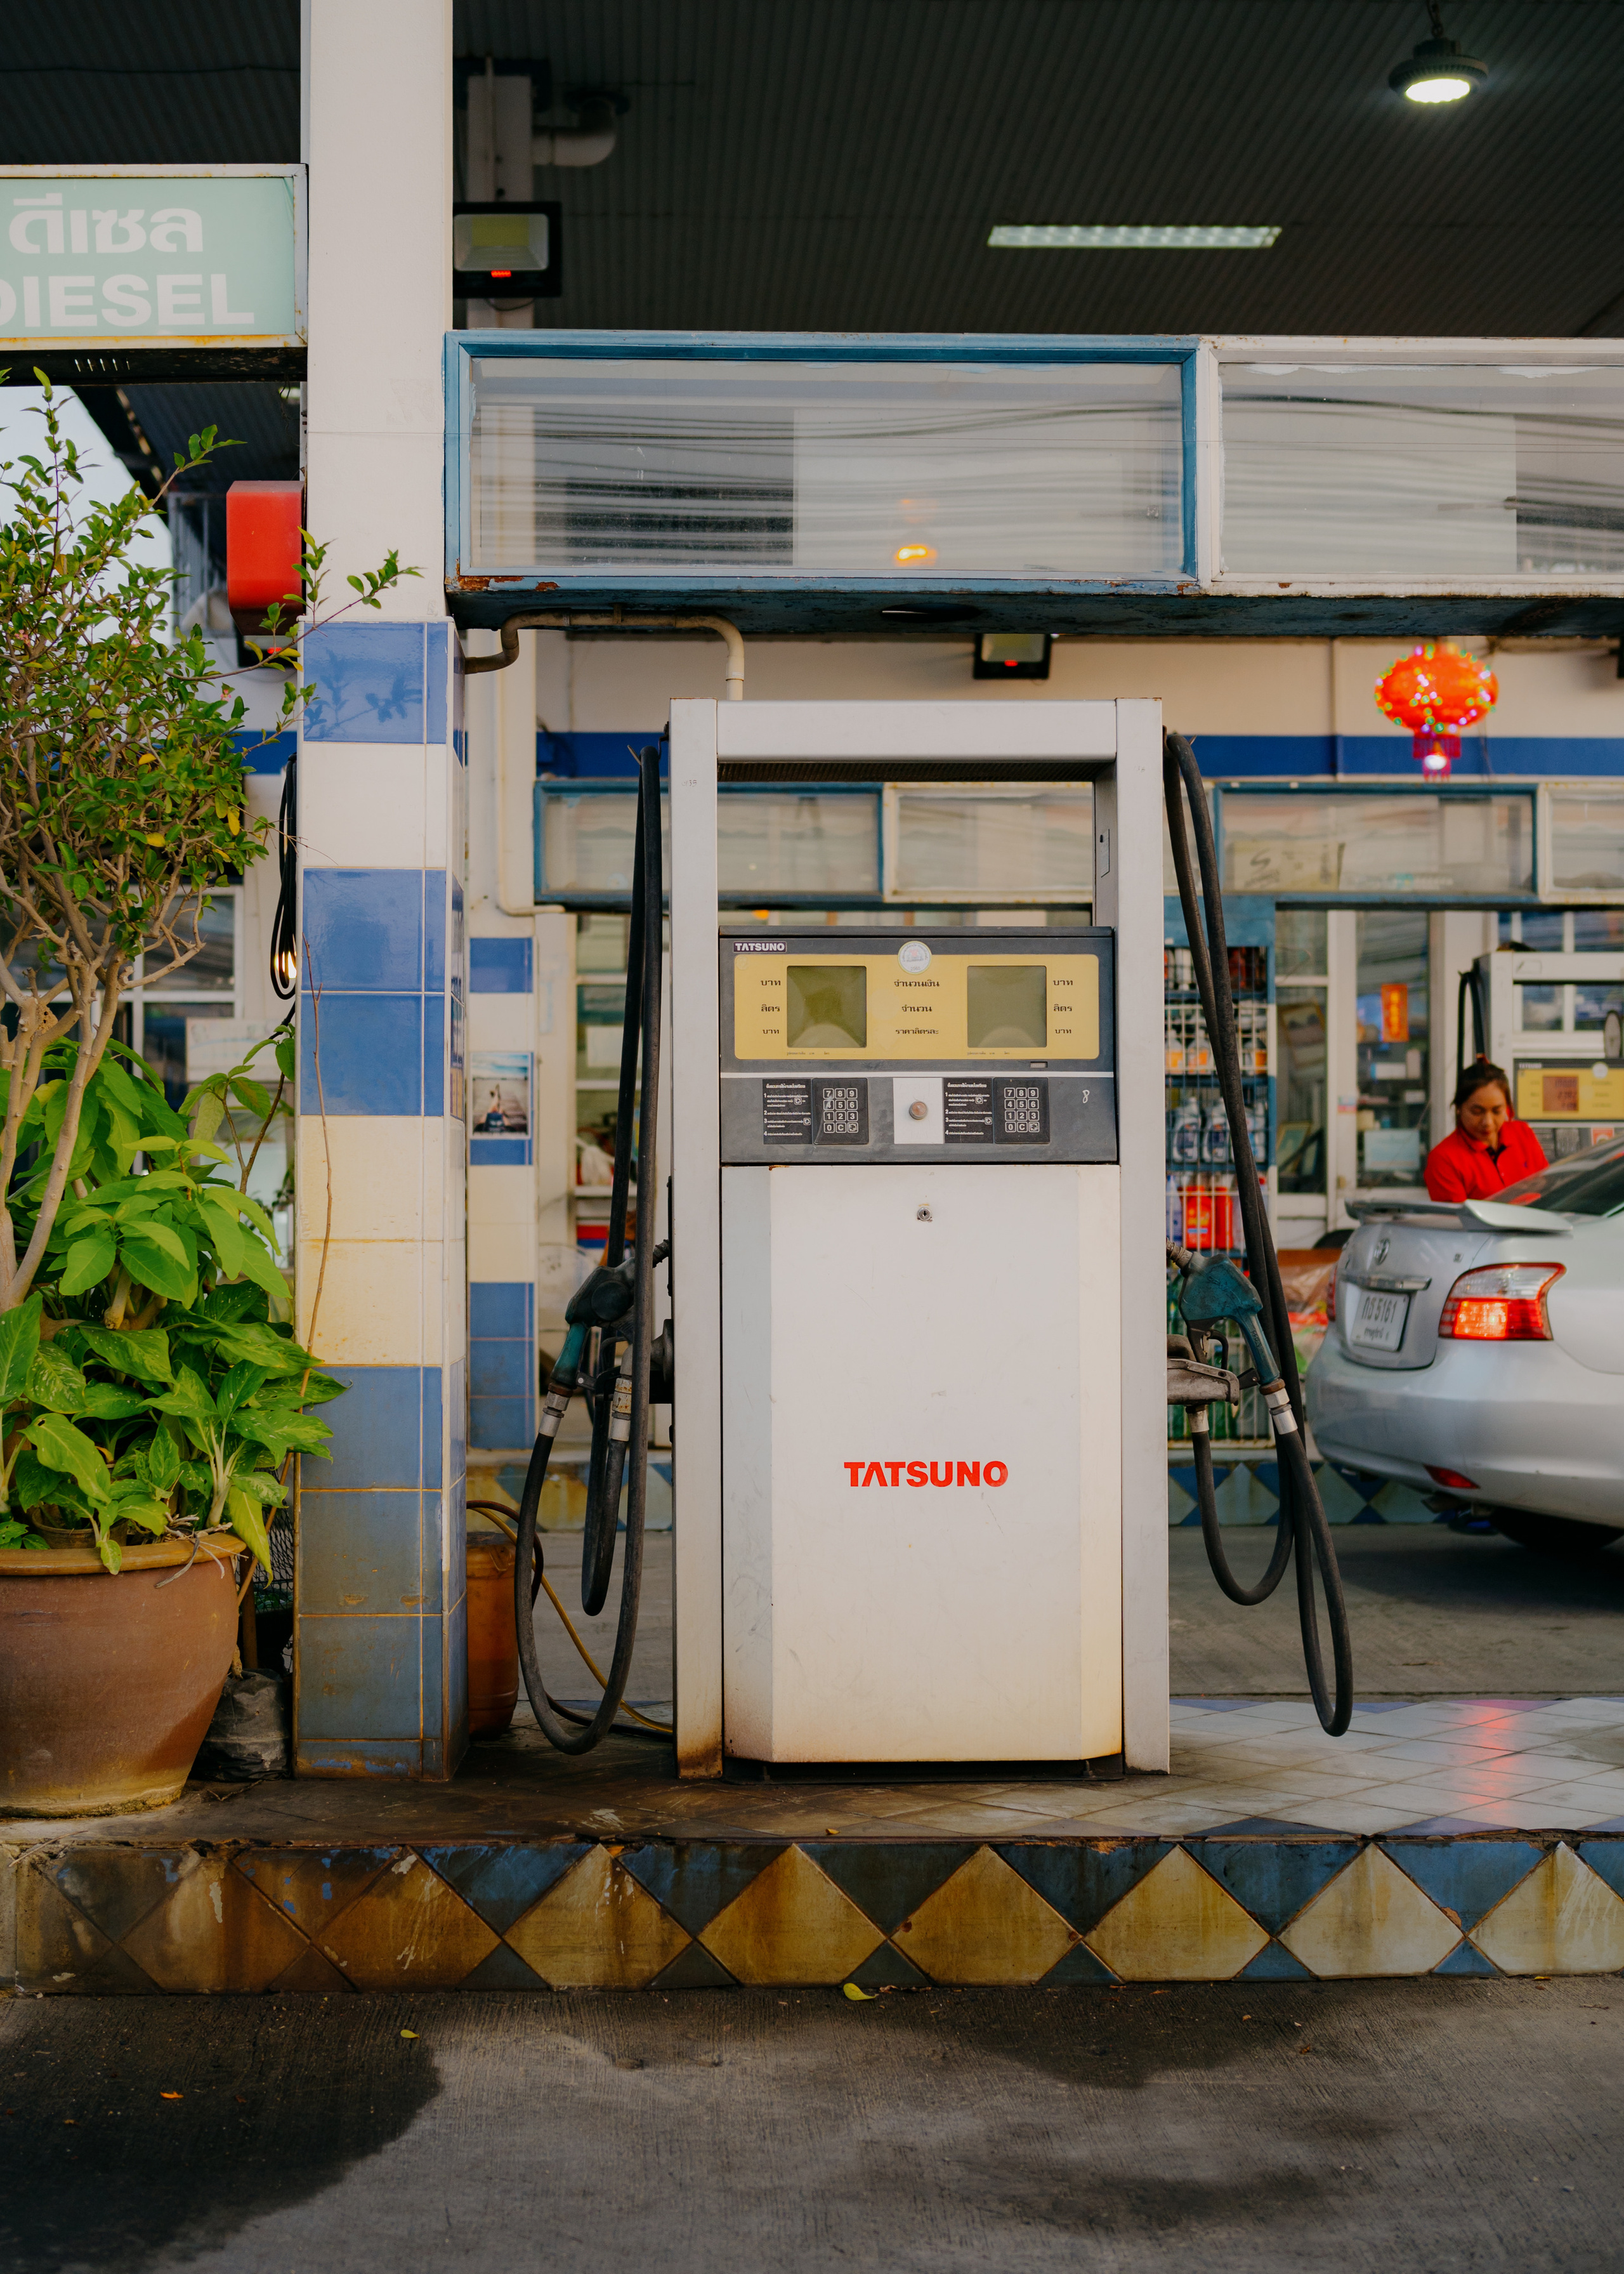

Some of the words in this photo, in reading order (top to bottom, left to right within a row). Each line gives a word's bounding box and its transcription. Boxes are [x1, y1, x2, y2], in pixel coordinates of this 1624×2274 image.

[9, 193, 204, 254] ดีเซล
[735, 943, 785, 951] TATSUNO
[894, 979, 940, 987] จำนวนเงิน
[761, 1003, 780, 1012] ลิตร
[1053, 1003, 1073, 1012] ลิตร
[844, 1461, 1009, 1487] TATSUNO
